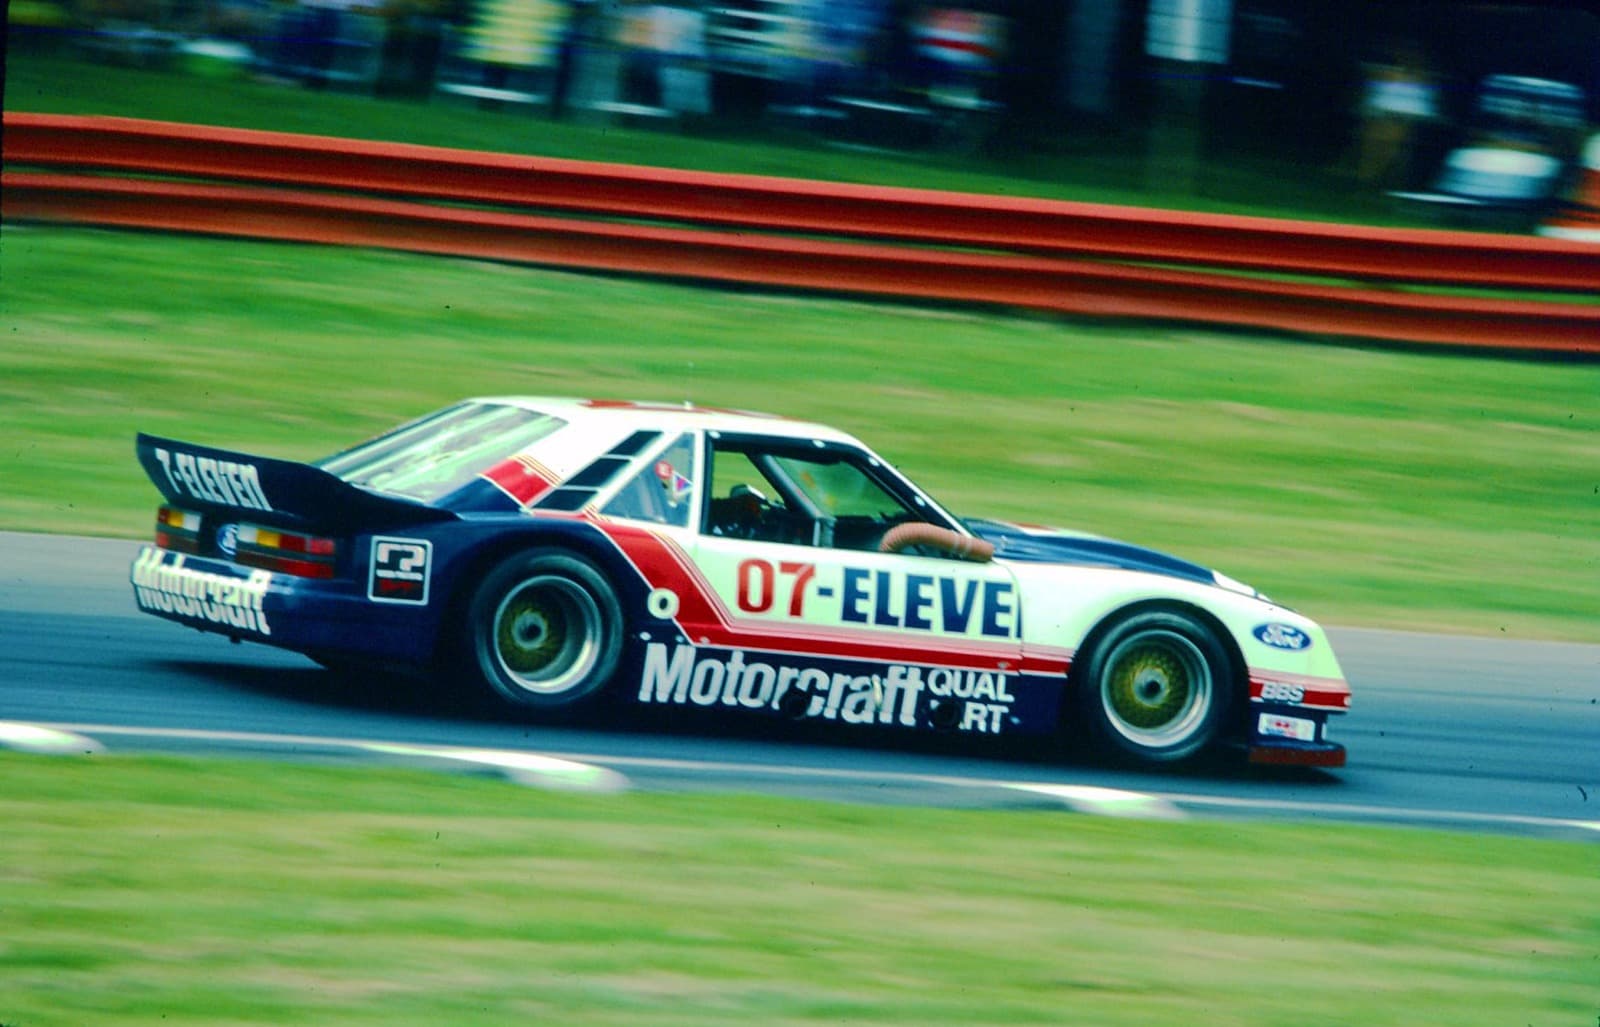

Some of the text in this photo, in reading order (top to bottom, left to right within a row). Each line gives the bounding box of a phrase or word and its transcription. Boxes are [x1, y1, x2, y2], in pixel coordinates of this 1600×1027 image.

[155, 447, 273, 512] 7-ELEVEN
[927, 669, 1015, 702] QUAL
[1261, 682, 1305, 702] BBS
